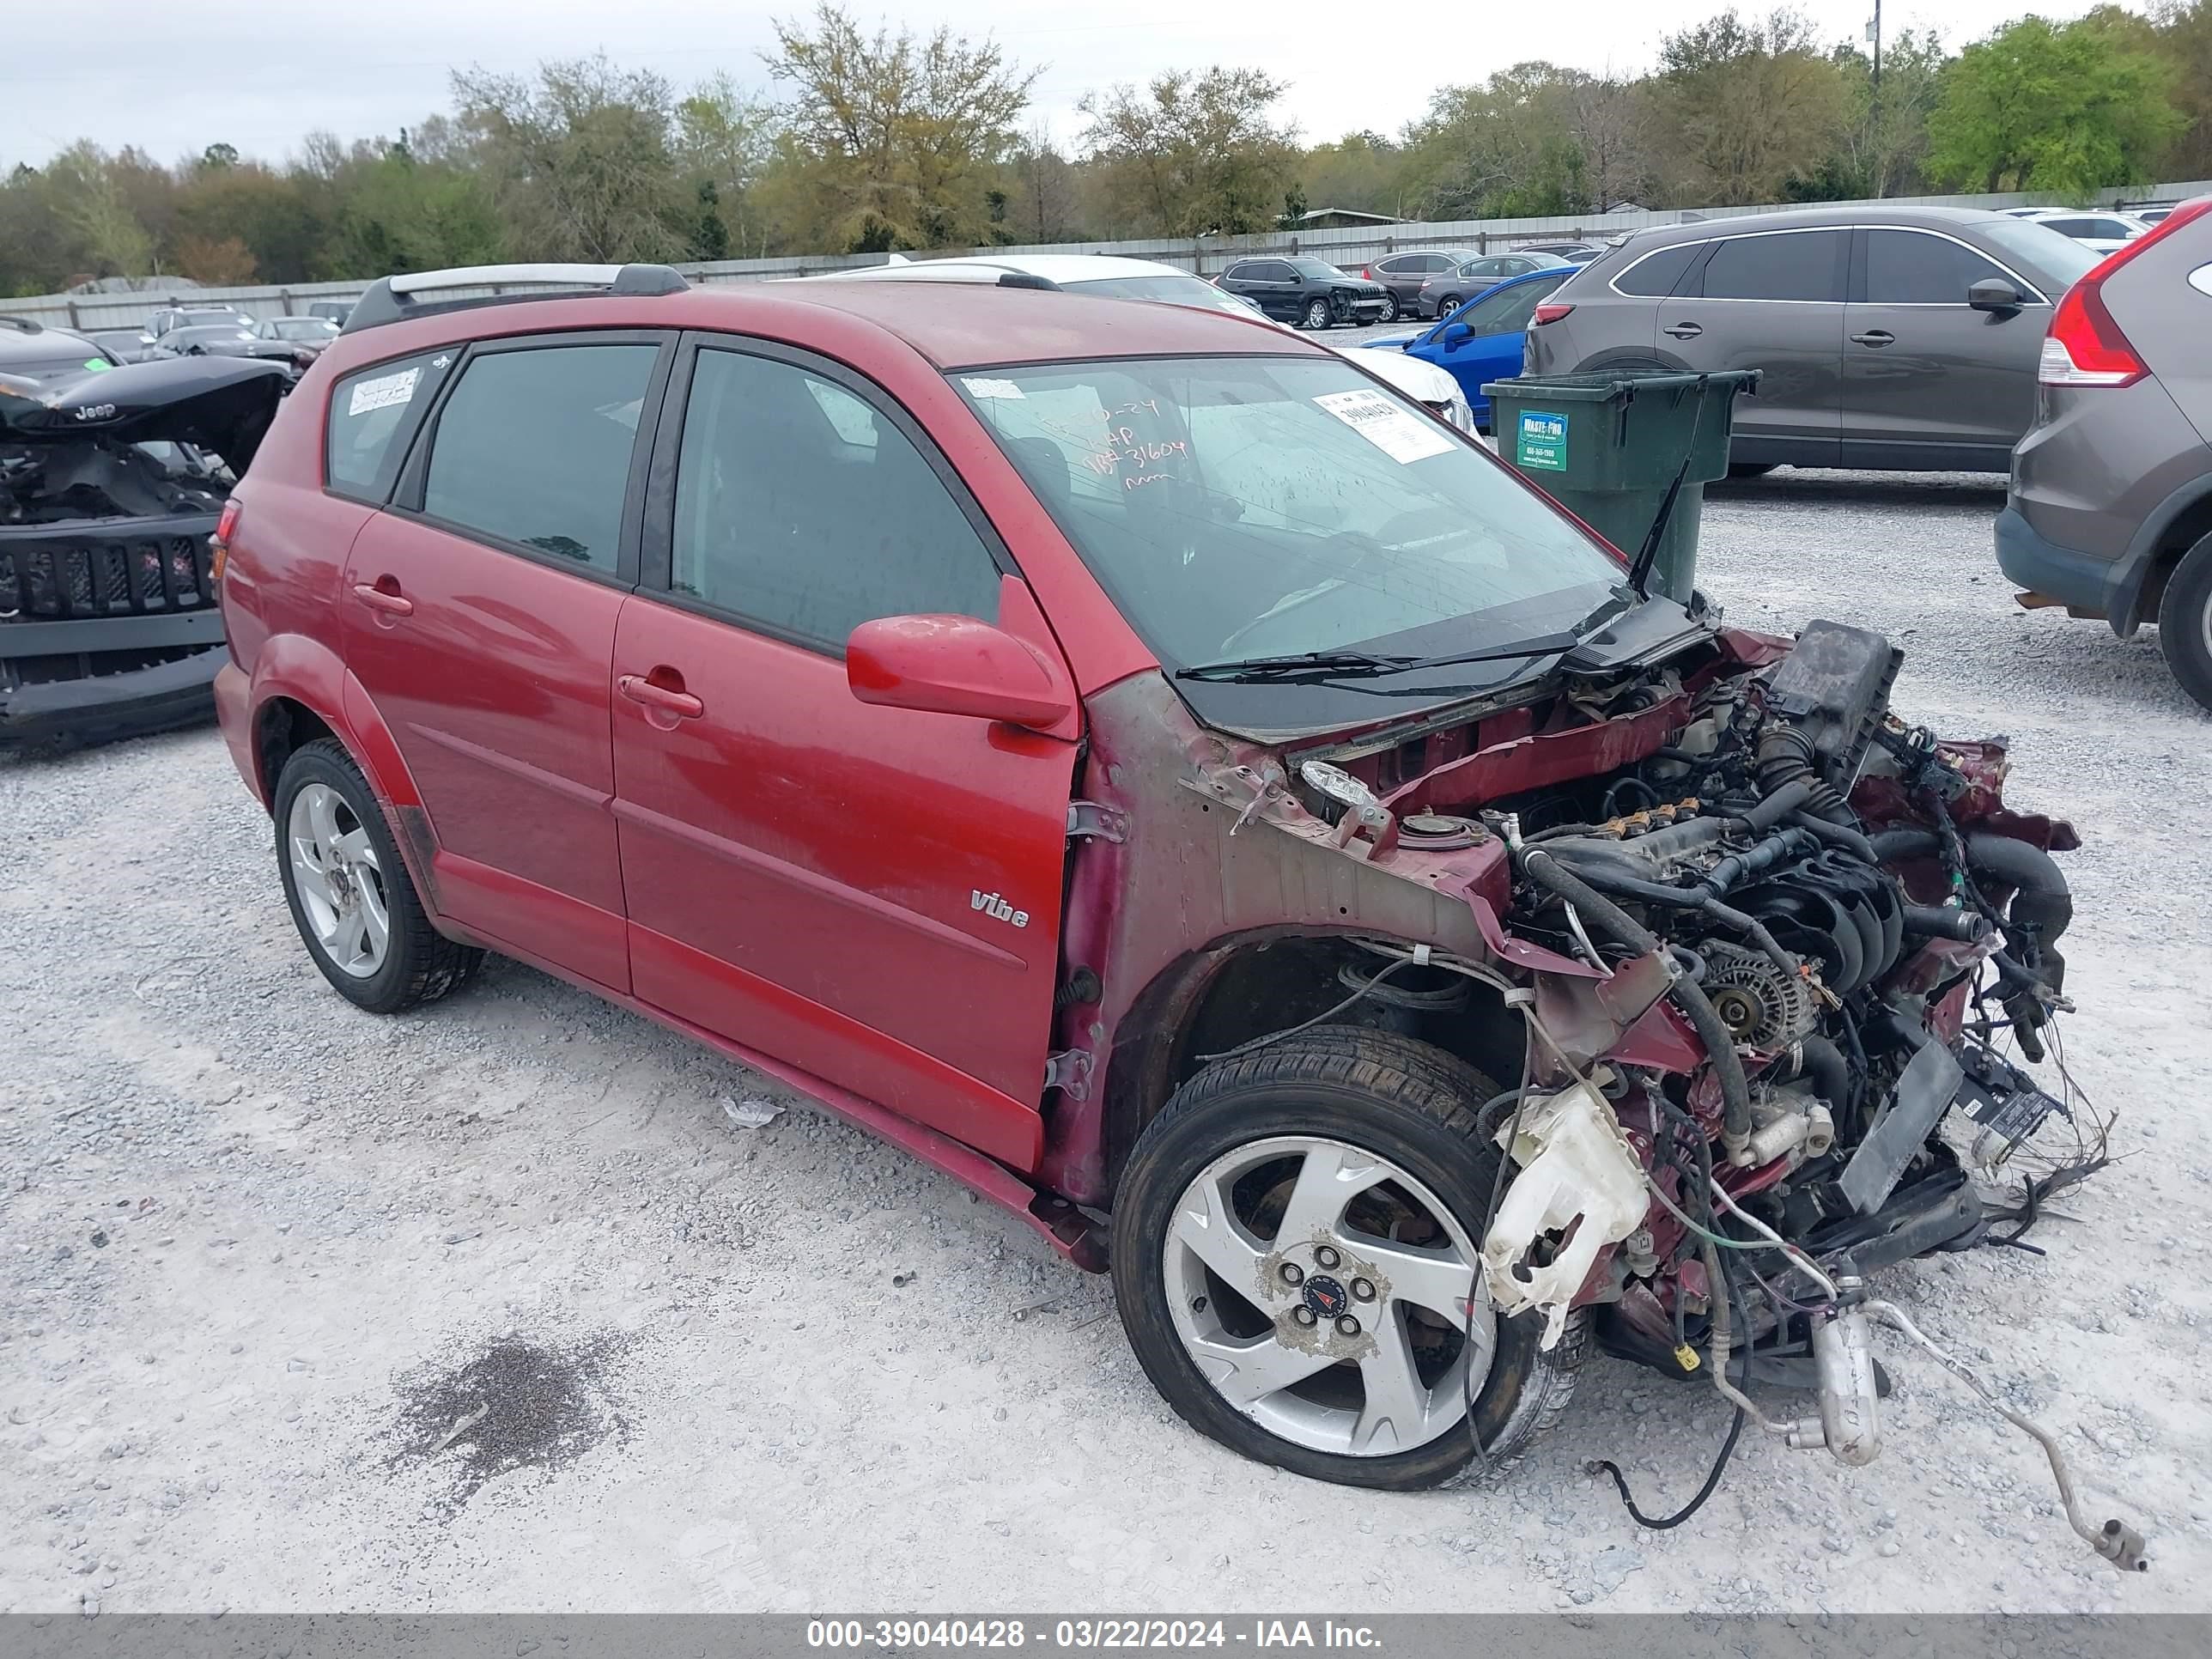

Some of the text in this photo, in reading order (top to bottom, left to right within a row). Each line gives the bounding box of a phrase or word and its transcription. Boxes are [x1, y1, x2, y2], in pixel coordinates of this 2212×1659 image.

[75, 404, 116, 420] Jeep
[1524, 418, 1547, 433] WASTE
[970, 890, 1029, 928] vibe
